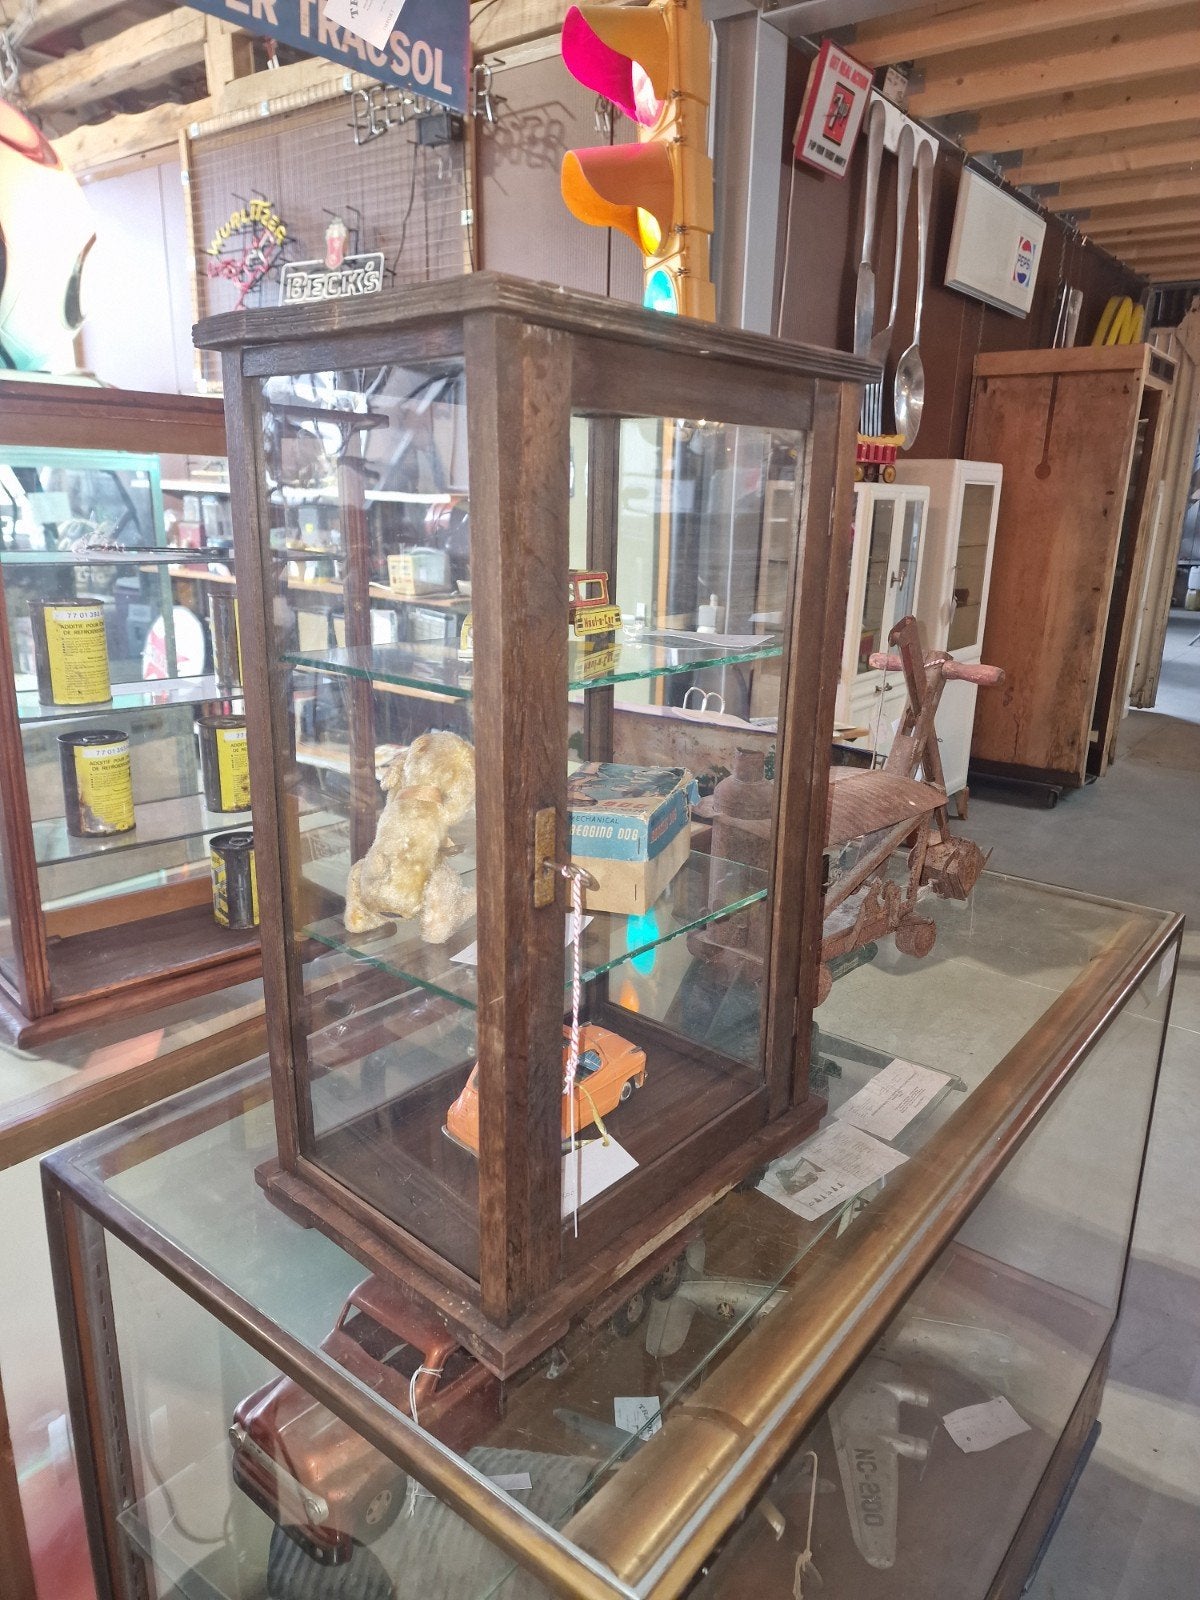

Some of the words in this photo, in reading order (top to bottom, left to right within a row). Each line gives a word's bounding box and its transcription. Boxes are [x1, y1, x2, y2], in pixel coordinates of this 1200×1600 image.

[206, 198, 288, 256] WURLITZER
[284, 260, 381, 304] BECK'S
[617, 827, 640, 841] DOG
